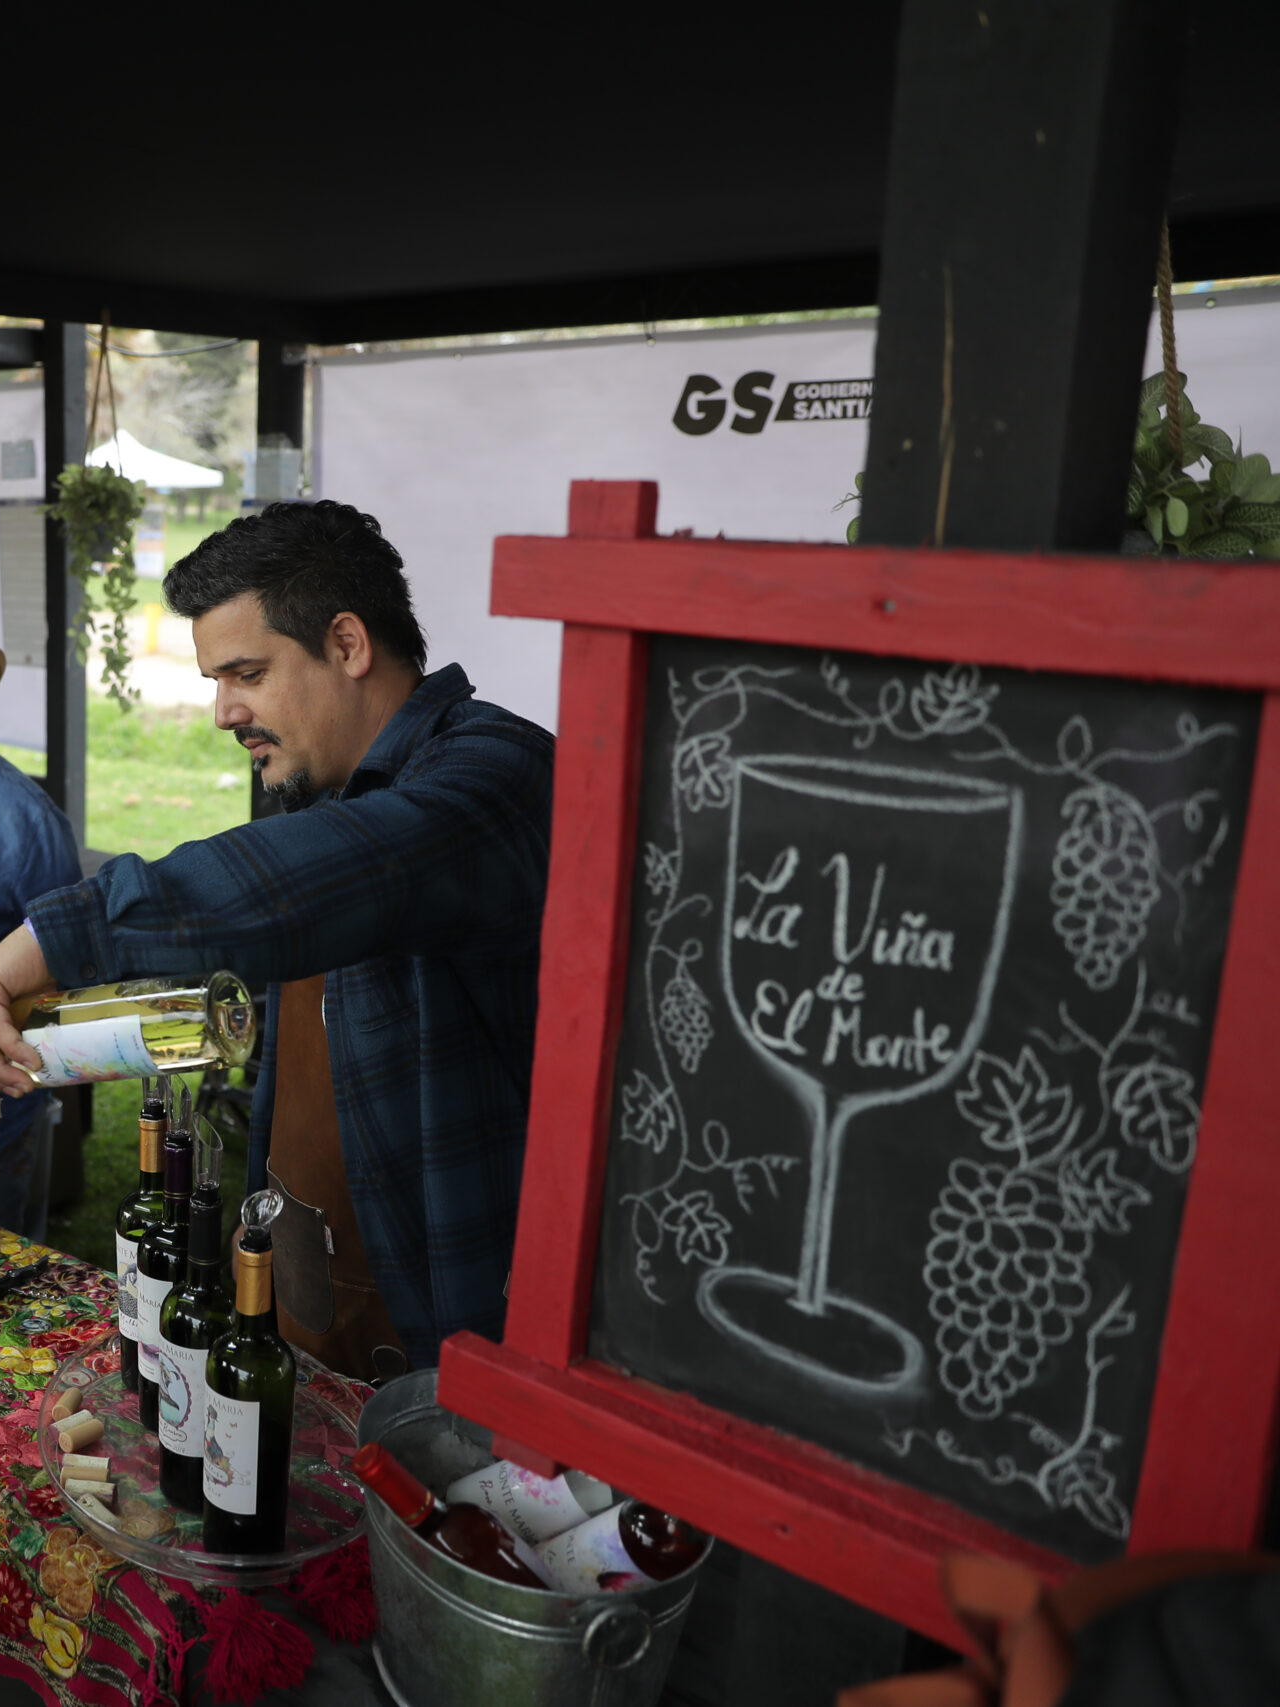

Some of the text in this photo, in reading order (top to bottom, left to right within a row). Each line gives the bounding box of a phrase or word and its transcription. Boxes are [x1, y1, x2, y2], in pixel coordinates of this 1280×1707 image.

[673, 371, 776, 436] GS
[793, 381, 873, 399] GOBIERN
[793, 400, 872, 419] SANTI
[733, 846, 954, 973] La Viña
[816, 965, 865, 1001] de
[751, 979, 955, 1074] El Monte
[166, 1345, 194, 1361] MARIA
[213, 1398, 244, 1416] MARIA
